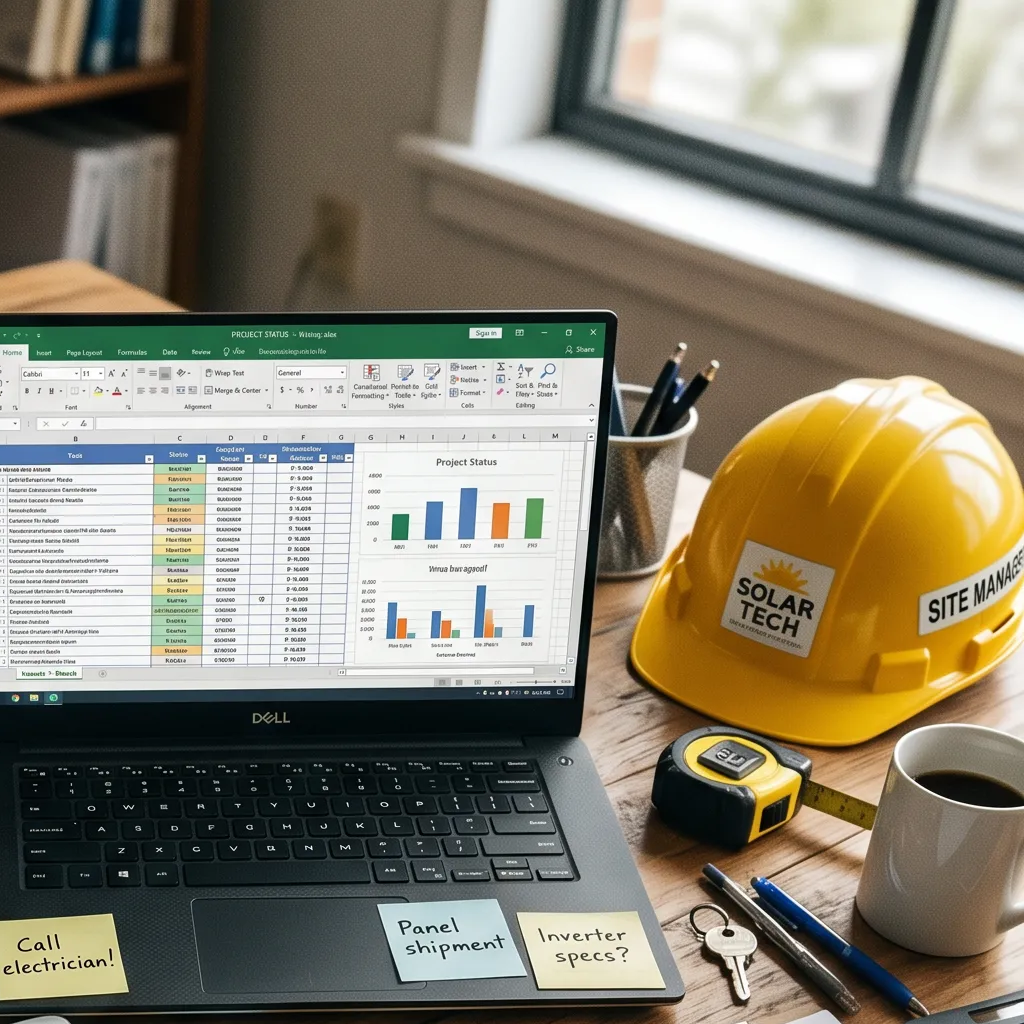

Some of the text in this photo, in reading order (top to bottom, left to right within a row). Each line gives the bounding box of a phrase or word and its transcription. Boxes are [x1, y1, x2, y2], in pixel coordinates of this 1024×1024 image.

[436, 458, 497, 468] Project Status
[928, 549, 1024, 623] SITE MANAGE
[737, 577, 815, 620] SOLAR
[740, 600, 800, 638] TECH
[252, 712, 290, 724] DELL
[397, 917, 459, 937] Panel
[538, 926, 627, 946] Inverter
[16, 933, 62, 953] Call
[405, 932, 505, 960] shipment
[2, 948, 115, 978] electrician!
[555, 945, 630, 966] specs?
